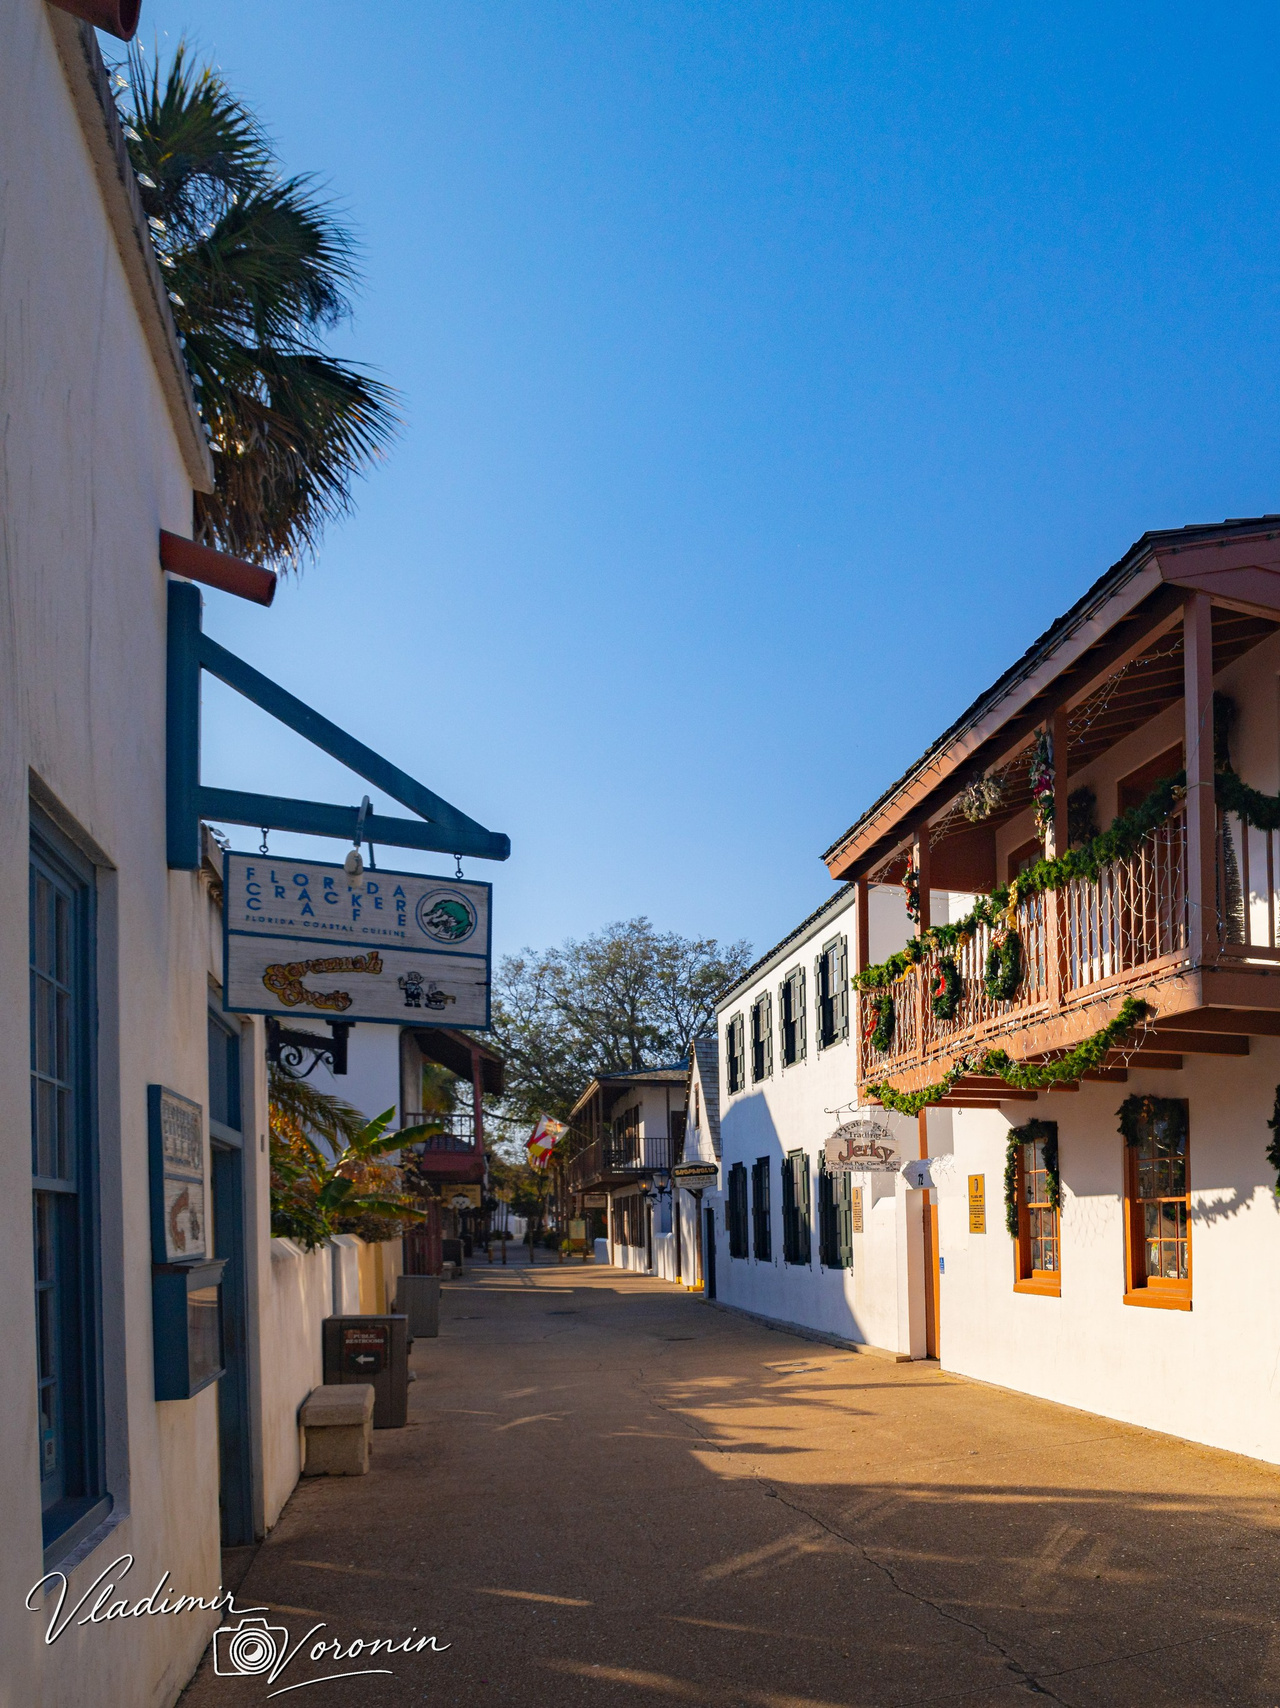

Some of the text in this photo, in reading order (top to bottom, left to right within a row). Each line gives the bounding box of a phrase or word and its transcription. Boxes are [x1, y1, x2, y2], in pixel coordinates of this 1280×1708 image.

[246, 867, 406, 898] FLORDA
[246, 882, 407, 912] CRACKER
[245, 914, 406, 939] FLORIDA COASTAL CUISINE
[246, 897, 407, 927] CAFE
[838, 1139, 895, 1164] Jerky
